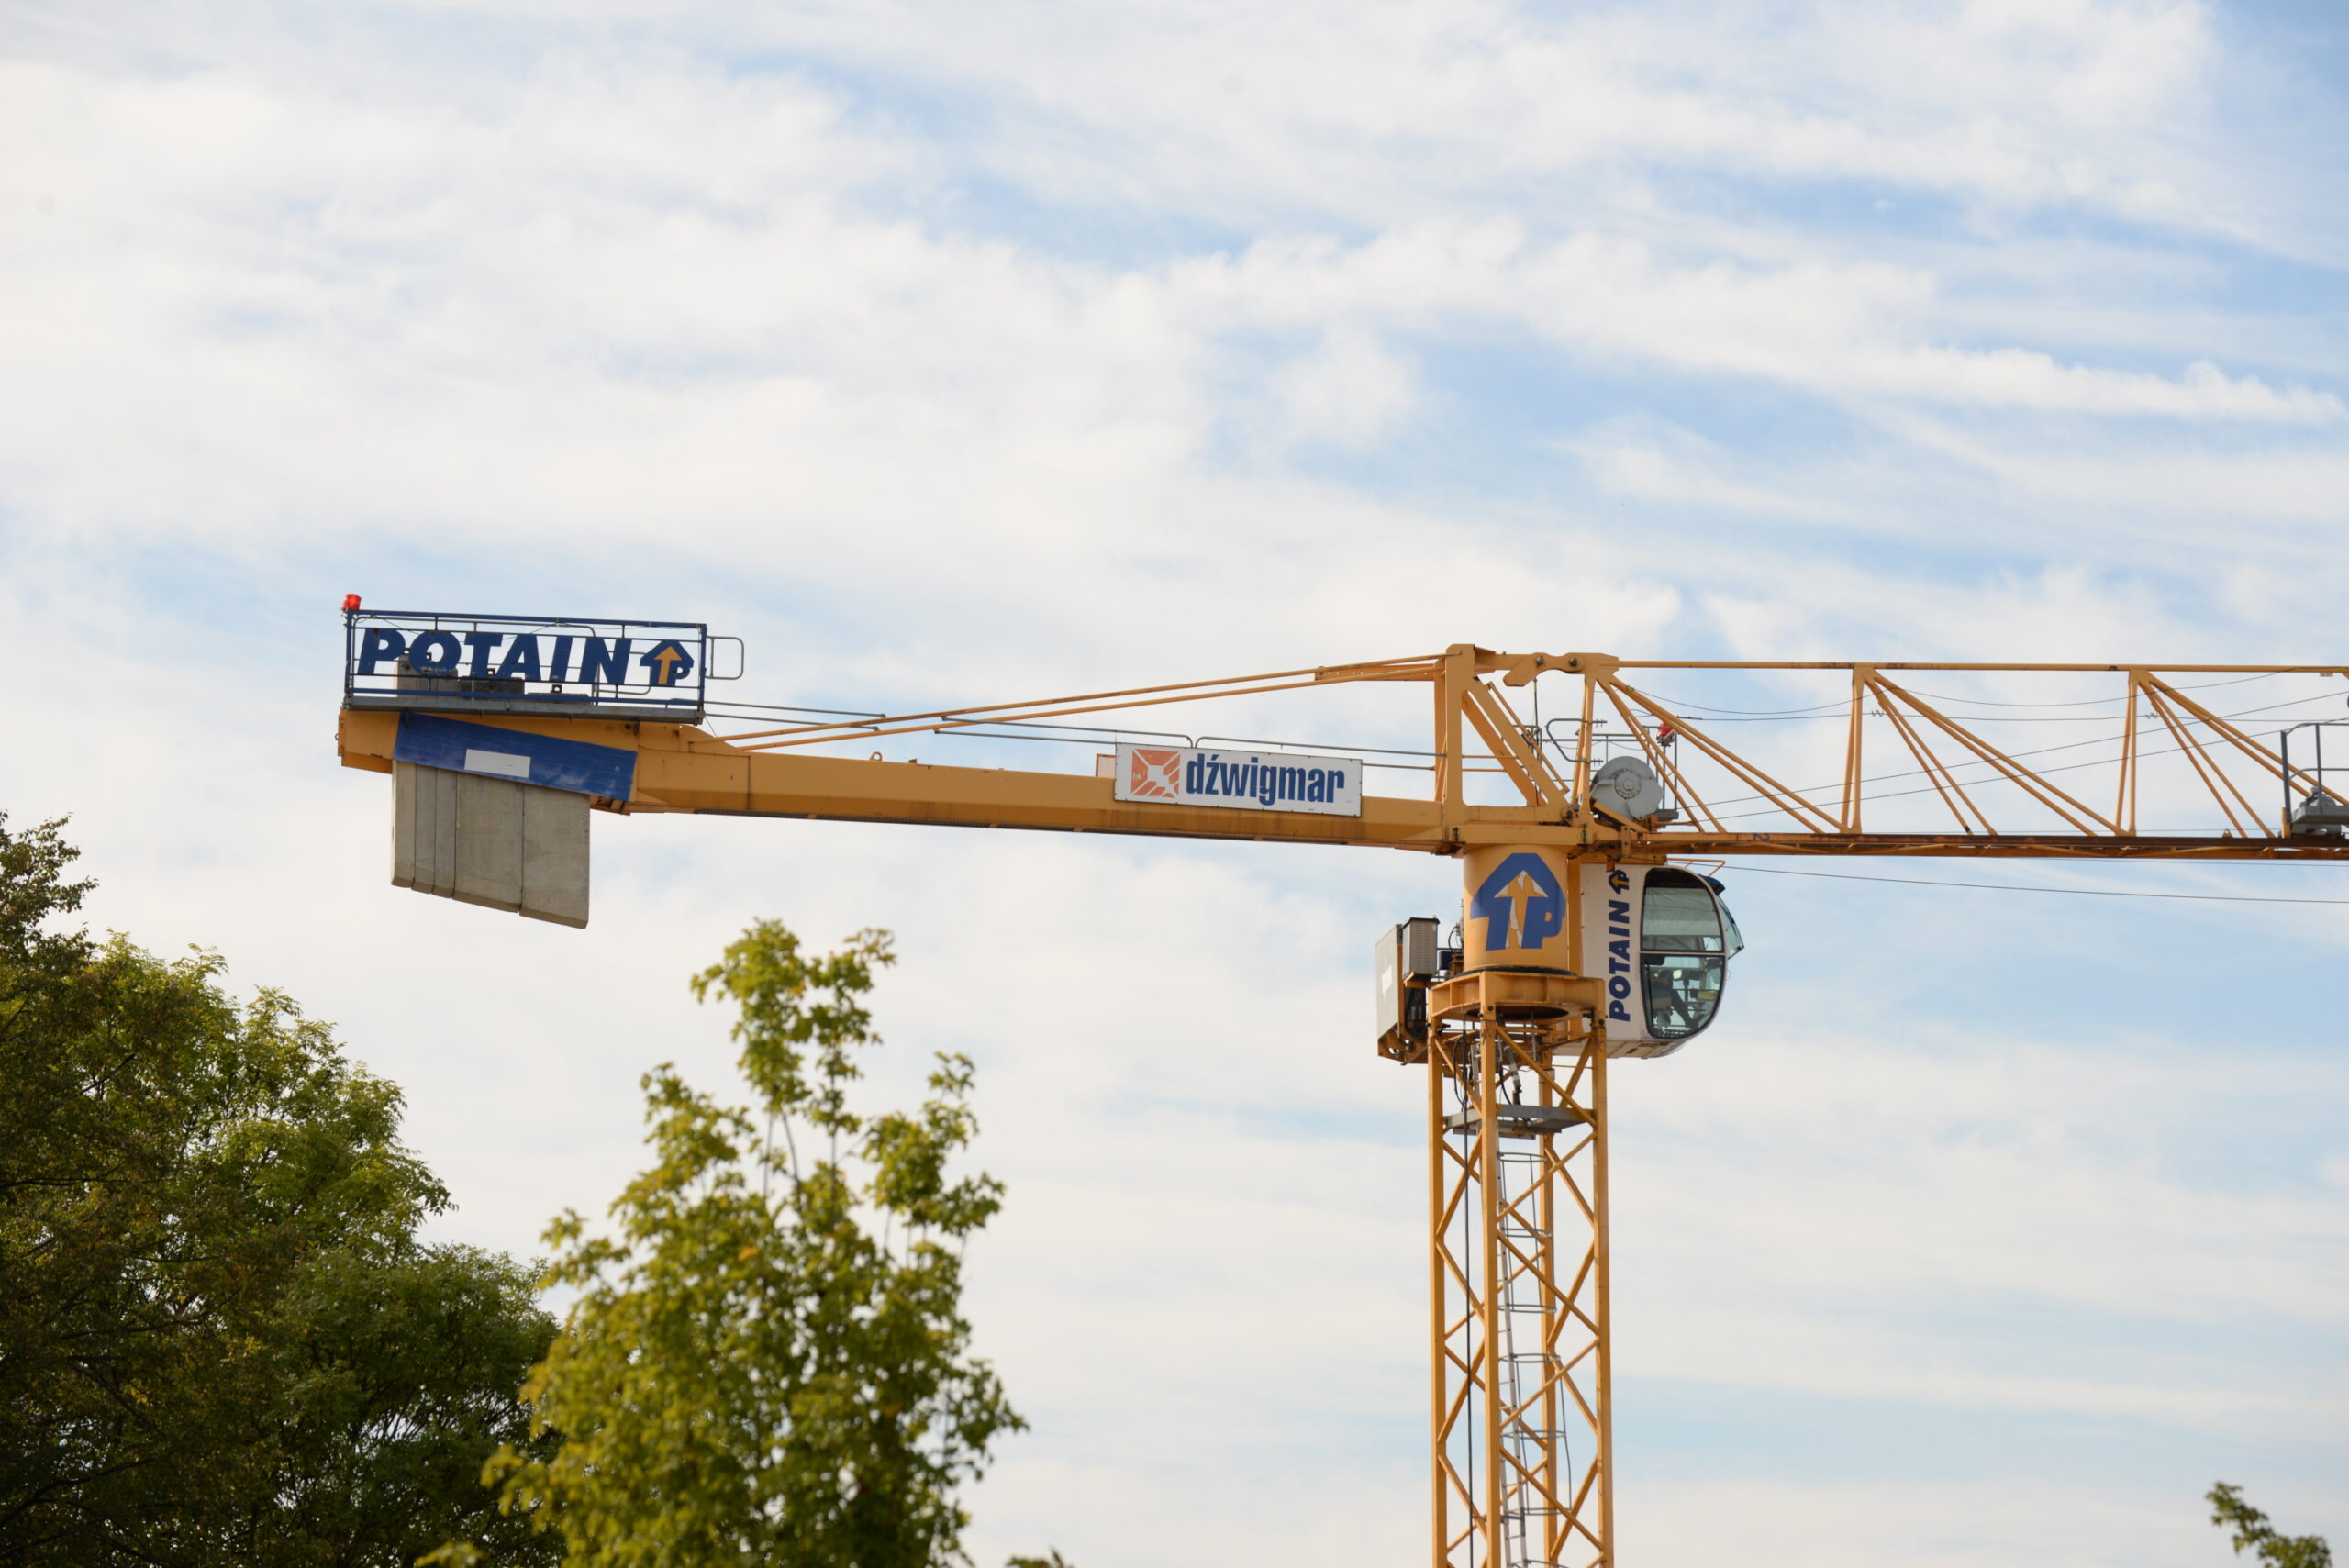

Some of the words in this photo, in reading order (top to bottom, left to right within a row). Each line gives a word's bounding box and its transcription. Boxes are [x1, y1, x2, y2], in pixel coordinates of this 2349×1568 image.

[358, 628, 631, 684] POTAIN
[1186, 752, 1345, 806] dźwigmar
[1609, 899, 1631, 1022] POTAIN
